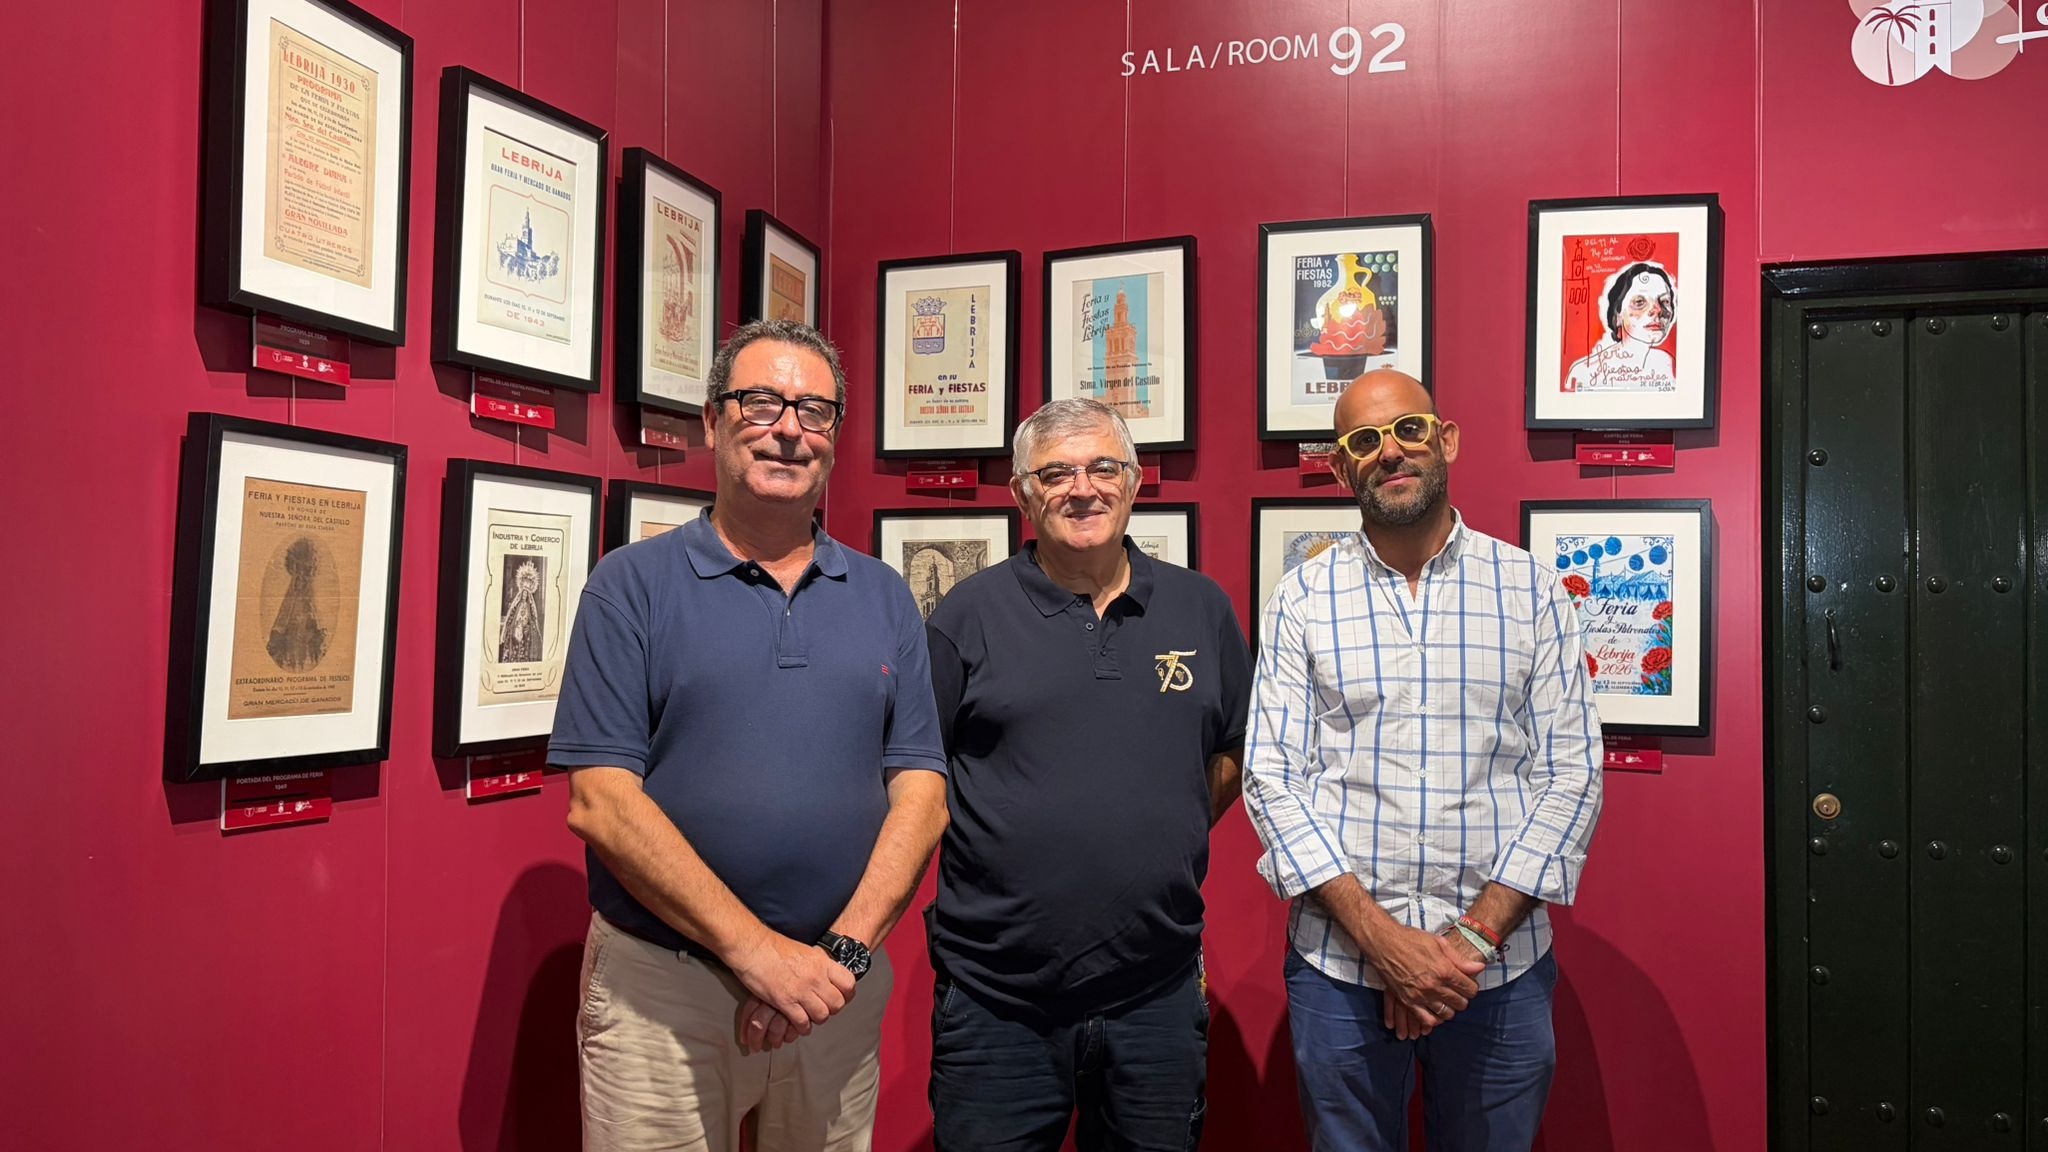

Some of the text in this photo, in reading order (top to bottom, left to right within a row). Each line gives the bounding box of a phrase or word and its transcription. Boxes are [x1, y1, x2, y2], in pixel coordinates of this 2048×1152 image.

[1121, 22, 1406, 76] SALA/ROOM 92
[283, 49, 356, 94] LEBRIJA 1930
[296, 75, 342, 102] PROGRAMA
[288, 154, 319, 172] ALEGRE
[501, 147, 563, 181] LEBRIJA
[504, 166, 517, 180] FERIA
[523, 175, 545, 191] MERCADO
[545, 184, 551, 193] DE
[552, 187, 571, 201] GANADOS
[284, 208, 306, 221] GRAN
[308, 216, 348, 236] NOVILLADA
[657, 202, 699, 232] LEBRIJA
[279, 225, 313, 241] CUATRO
[1603, 247, 1614, 256] DE
[1296, 257, 1330, 269] FERIA Y
[1296, 268, 1333, 280] FIESTAS
[1313, 280, 1332, 288] 1982
[1081, 293, 1102, 312] Feria
[506, 309, 520, 320] DE
[1082, 308, 1109, 329] Fiestas
[968, 293, 977, 369] LEBRIJA
[1082, 323, 1110, 343] Lebrija
[1595, 343, 1634, 374] feria
[1100, 378, 1122, 390] Virgen
[1123, 377, 1133, 387] del
[1135, 375, 1160, 386] Castillo
[1602, 362, 1642, 385] fiestas
[1610, 369, 1668, 387] patronales
[908, 382, 986, 396] FERIA y FIESTAS
[248, 490, 272, 501] FERIA
[283, 494, 316, 506] FIESTAS
[319, 498, 329, 507] EN
[331, 500, 361, 511] LEBRIJA
[259, 511, 351, 526] NUESTRA SEÑORA DEL CASTILLO
[520, 543, 543, 551] LEBRIJA
[1584, 597, 1638, 616] Feria
[1581, 619, 1660, 634] Fiestas Patronales
[1606, 615, 1614, 625] y
[1607, 635, 1617, 644] de
[1595, 644, 1636, 663] Lebrija
[1600, 663, 1633, 675] 2026
[236, 677, 284, 686] EXTRAORDINARIO
[243, 699, 263, 707] GRAN
[265, 698, 298, 706] MERCADO
[272, 773, 301, 782] PROGRAMA
